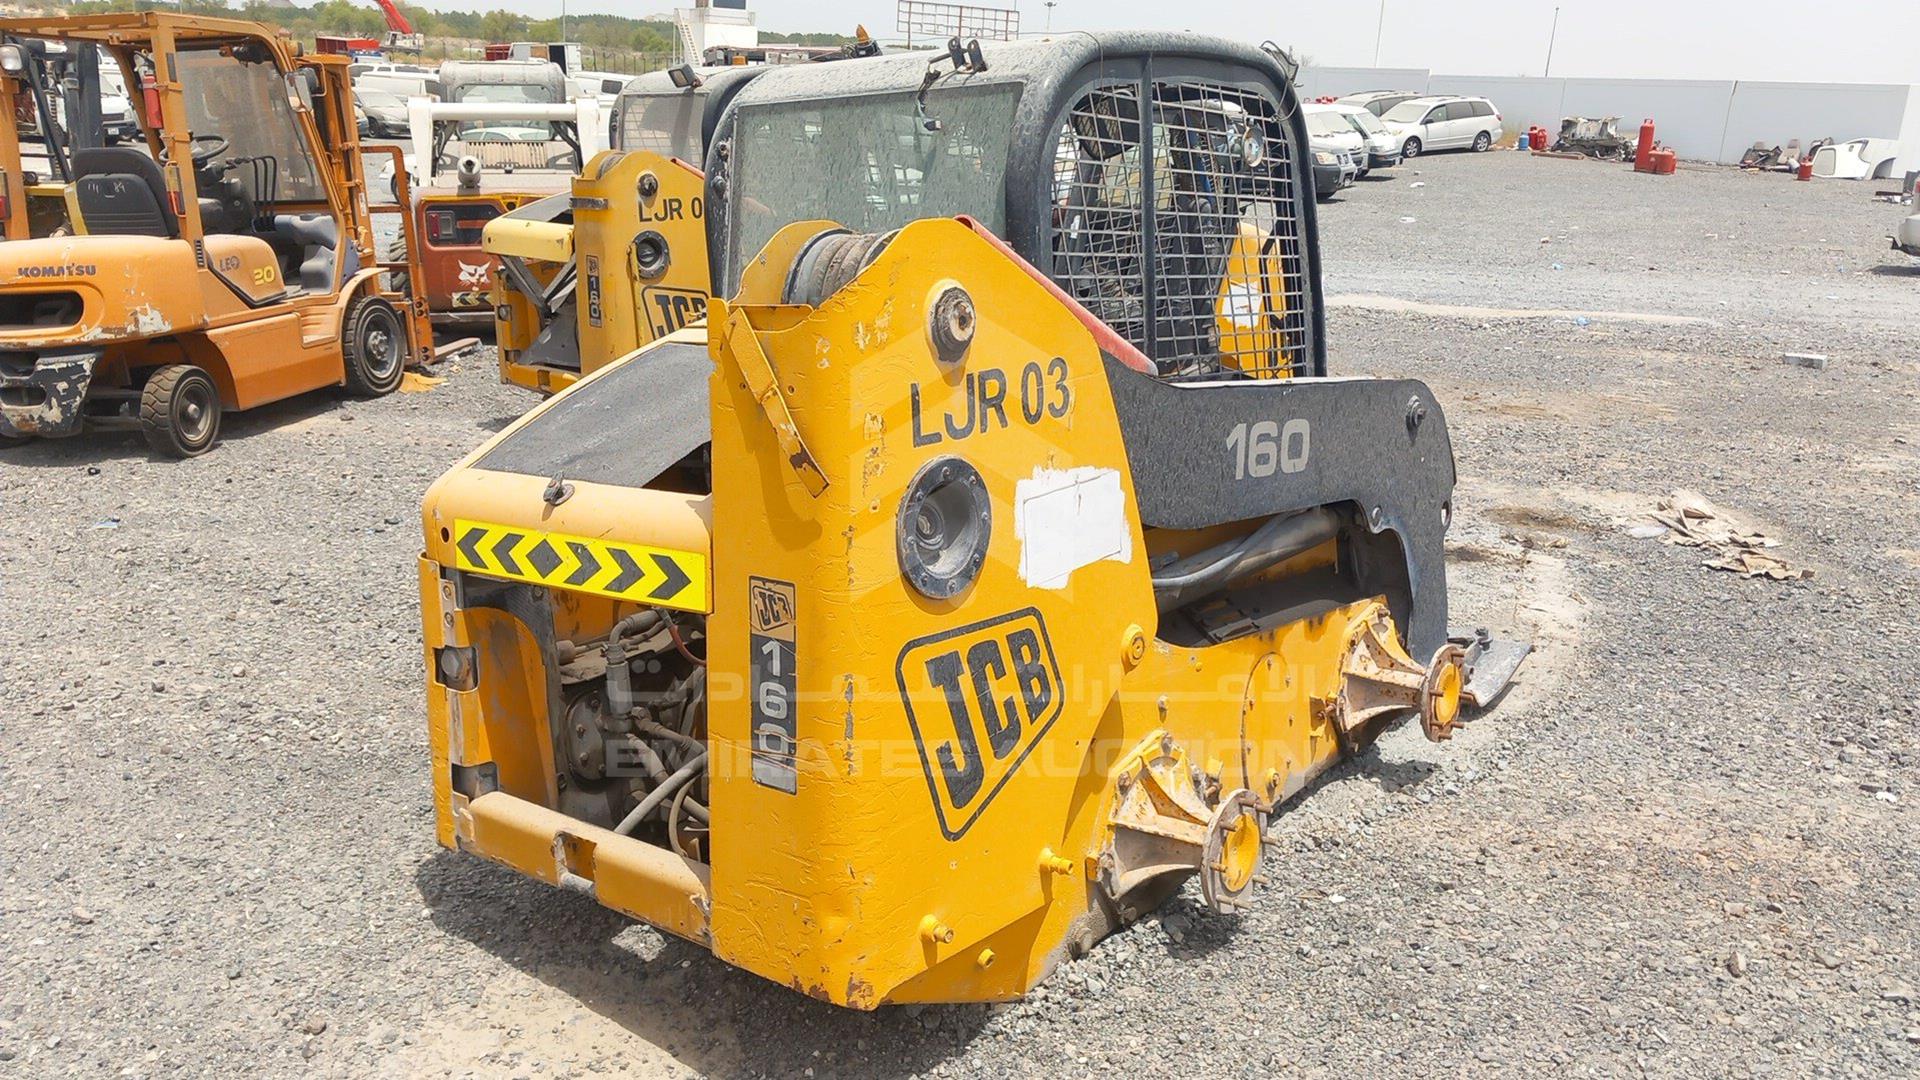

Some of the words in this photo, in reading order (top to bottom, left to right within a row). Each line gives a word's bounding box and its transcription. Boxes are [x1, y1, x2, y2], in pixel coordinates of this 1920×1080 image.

[638, 198, 683, 223] LJR
[18, 265, 97, 278] KOMATSU
[253, 265, 275, 286] 20
[590, 276, 600, 318] 160
[910, 368, 1009, 448] LJR
[1020, 356, 1071, 425] 03
[1225, 418, 1311, 480] 160
[758, 639, 790, 763] 160
[925, 627, 1052, 810] JCB
